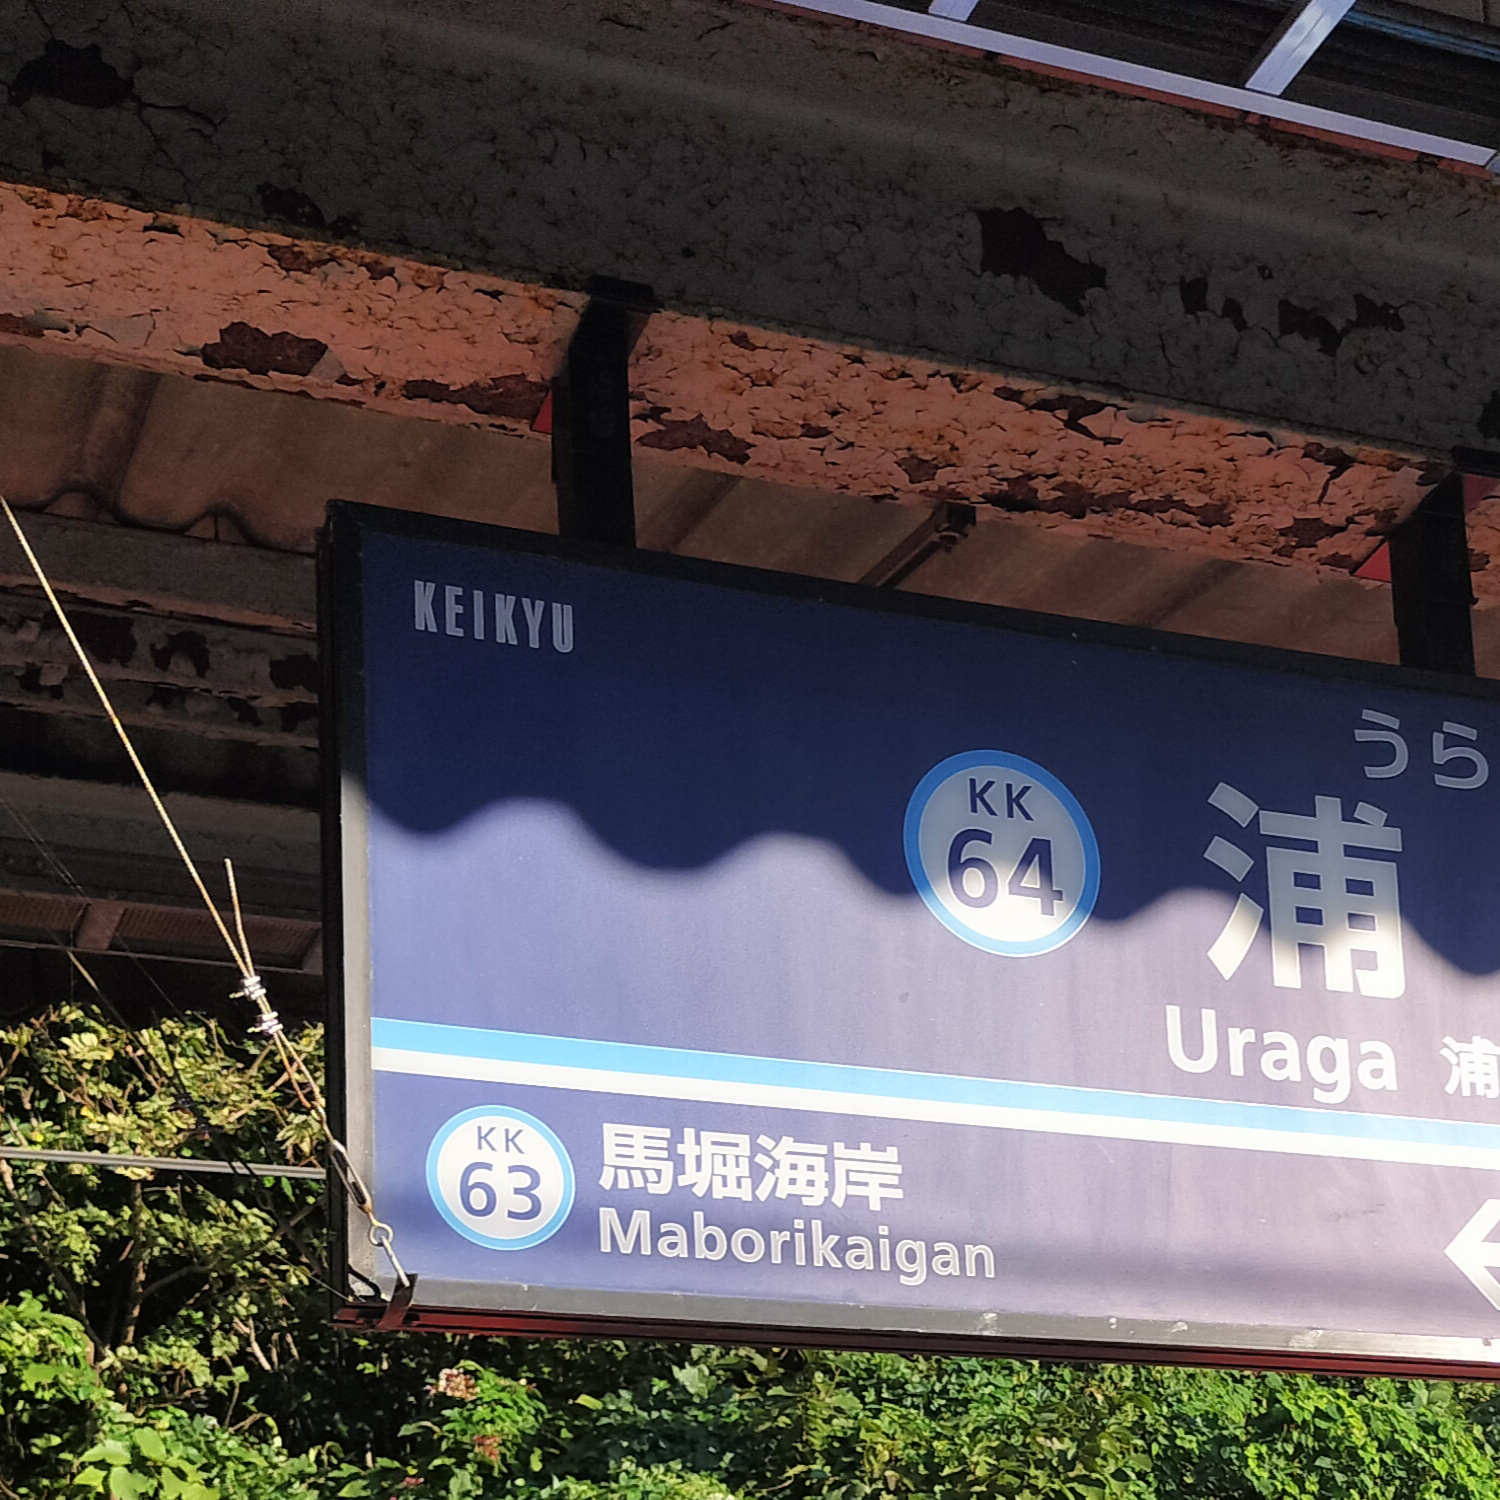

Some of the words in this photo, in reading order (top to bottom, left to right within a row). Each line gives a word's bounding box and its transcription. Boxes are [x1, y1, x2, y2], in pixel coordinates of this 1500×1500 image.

[413, 579, 575, 653] KEIKYU
[967, 776, 1035, 823] KK
[945, 827, 1064, 918] 64
[1165, 1004, 1398, 1104] Uraga
[475, 1124, 526, 1156] KK
[598, 1122, 905, 1211] 馬堀海岸
[457, 1162, 543, 1222] 63
[598, 1207, 997, 1287] Maborikaigan
